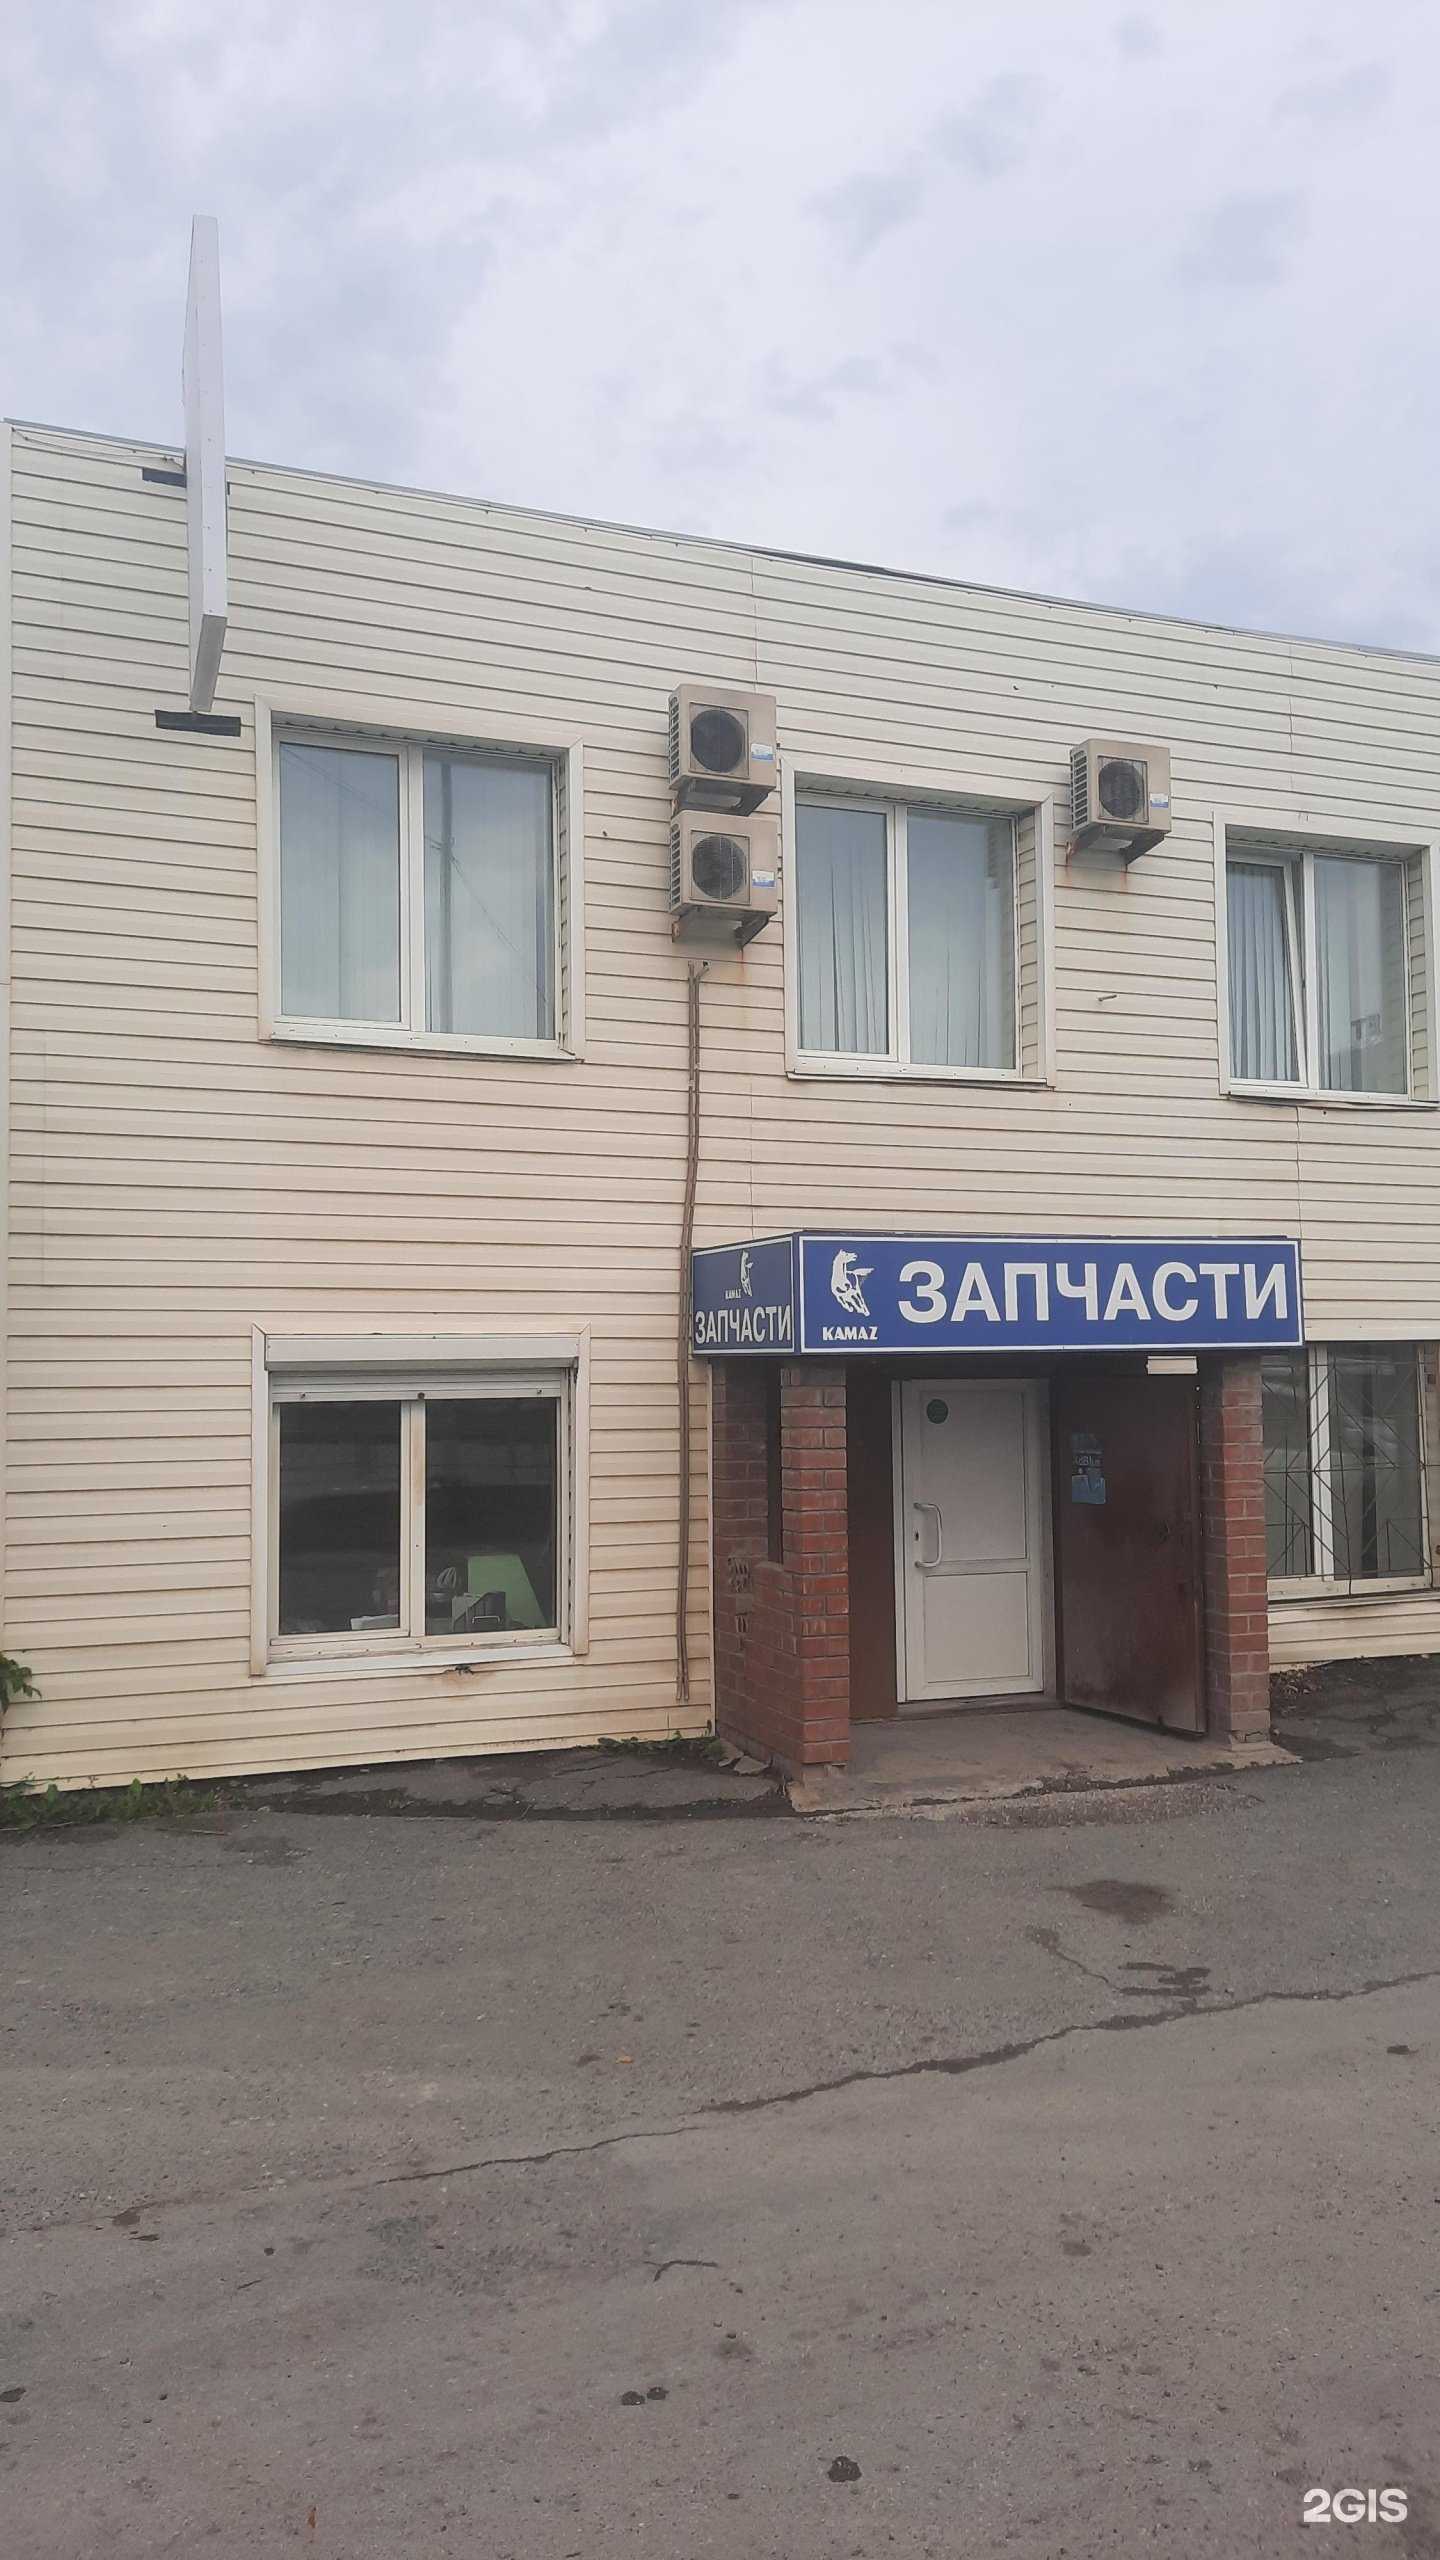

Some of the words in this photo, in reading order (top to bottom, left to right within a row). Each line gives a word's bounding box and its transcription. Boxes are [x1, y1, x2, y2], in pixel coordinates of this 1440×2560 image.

[898, 1260, 1288, 1323] ЗАПЧАСТИ
[695, 1304, 791, 1344] ЗАПЧАСТИ
[822, 1326, 878, 1341] KAMAZ
